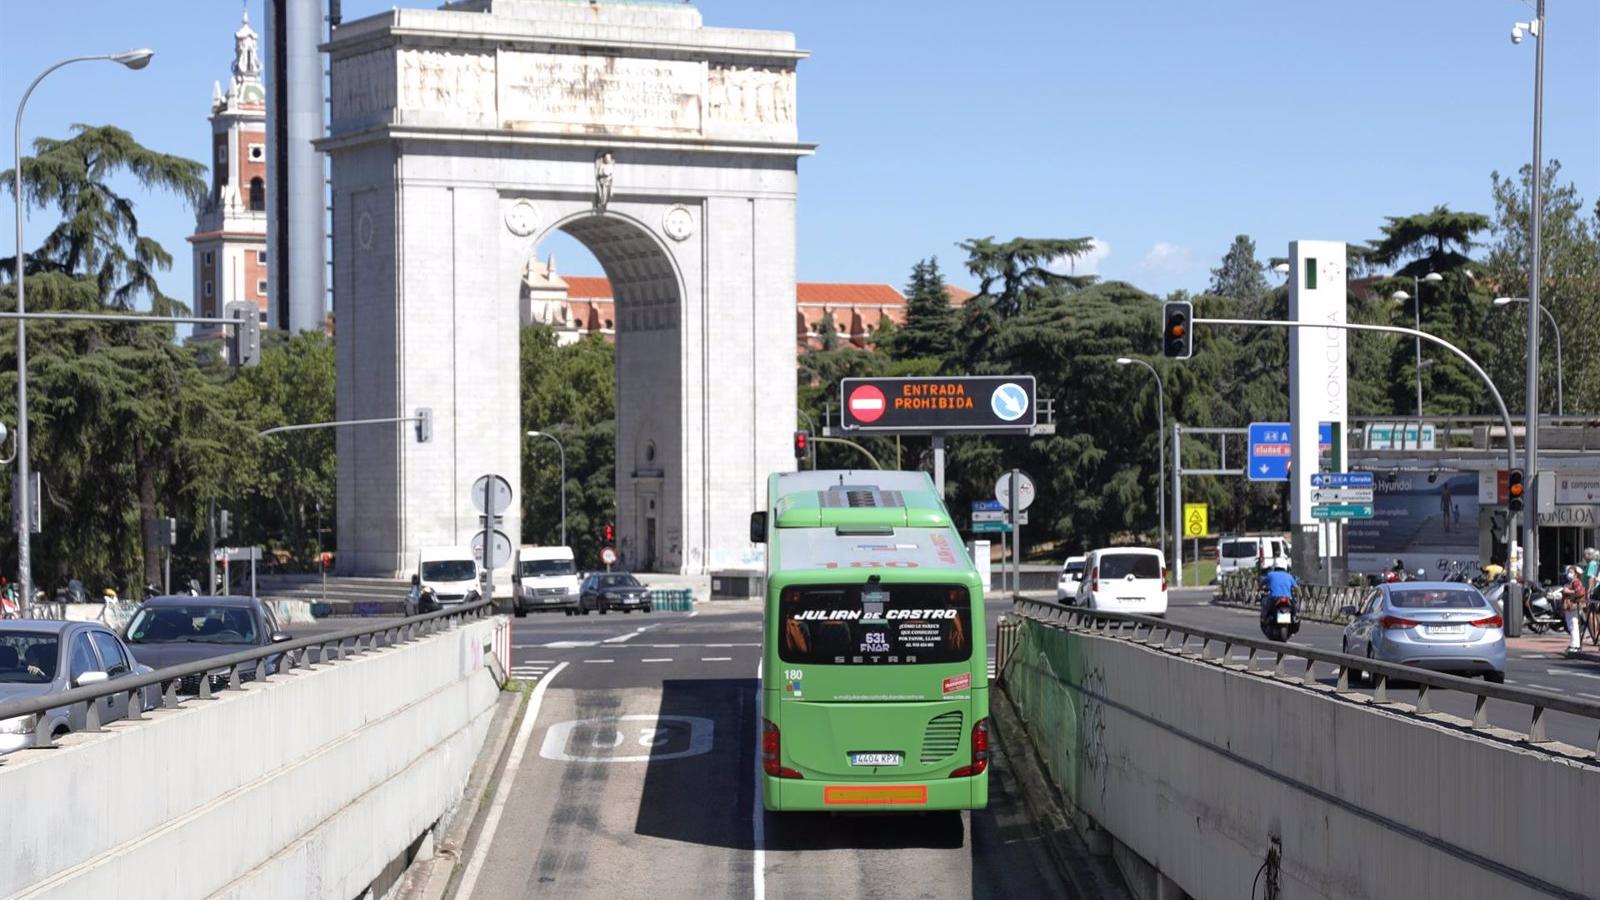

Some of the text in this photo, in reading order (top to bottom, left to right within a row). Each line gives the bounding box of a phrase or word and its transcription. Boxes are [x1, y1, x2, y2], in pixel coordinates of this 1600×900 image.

[903, 384, 964, 395] ENTRADA
[895, 397, 973, 409] PROHIBIDA
[794, 609, 861, 620] JULIAN
[886, 609, 957, 619] CASTRO
[865, 633, 885, 643] 631
[784, 669, 803, 680] 180
[858, 753, 897, 763] 4404 KPX
